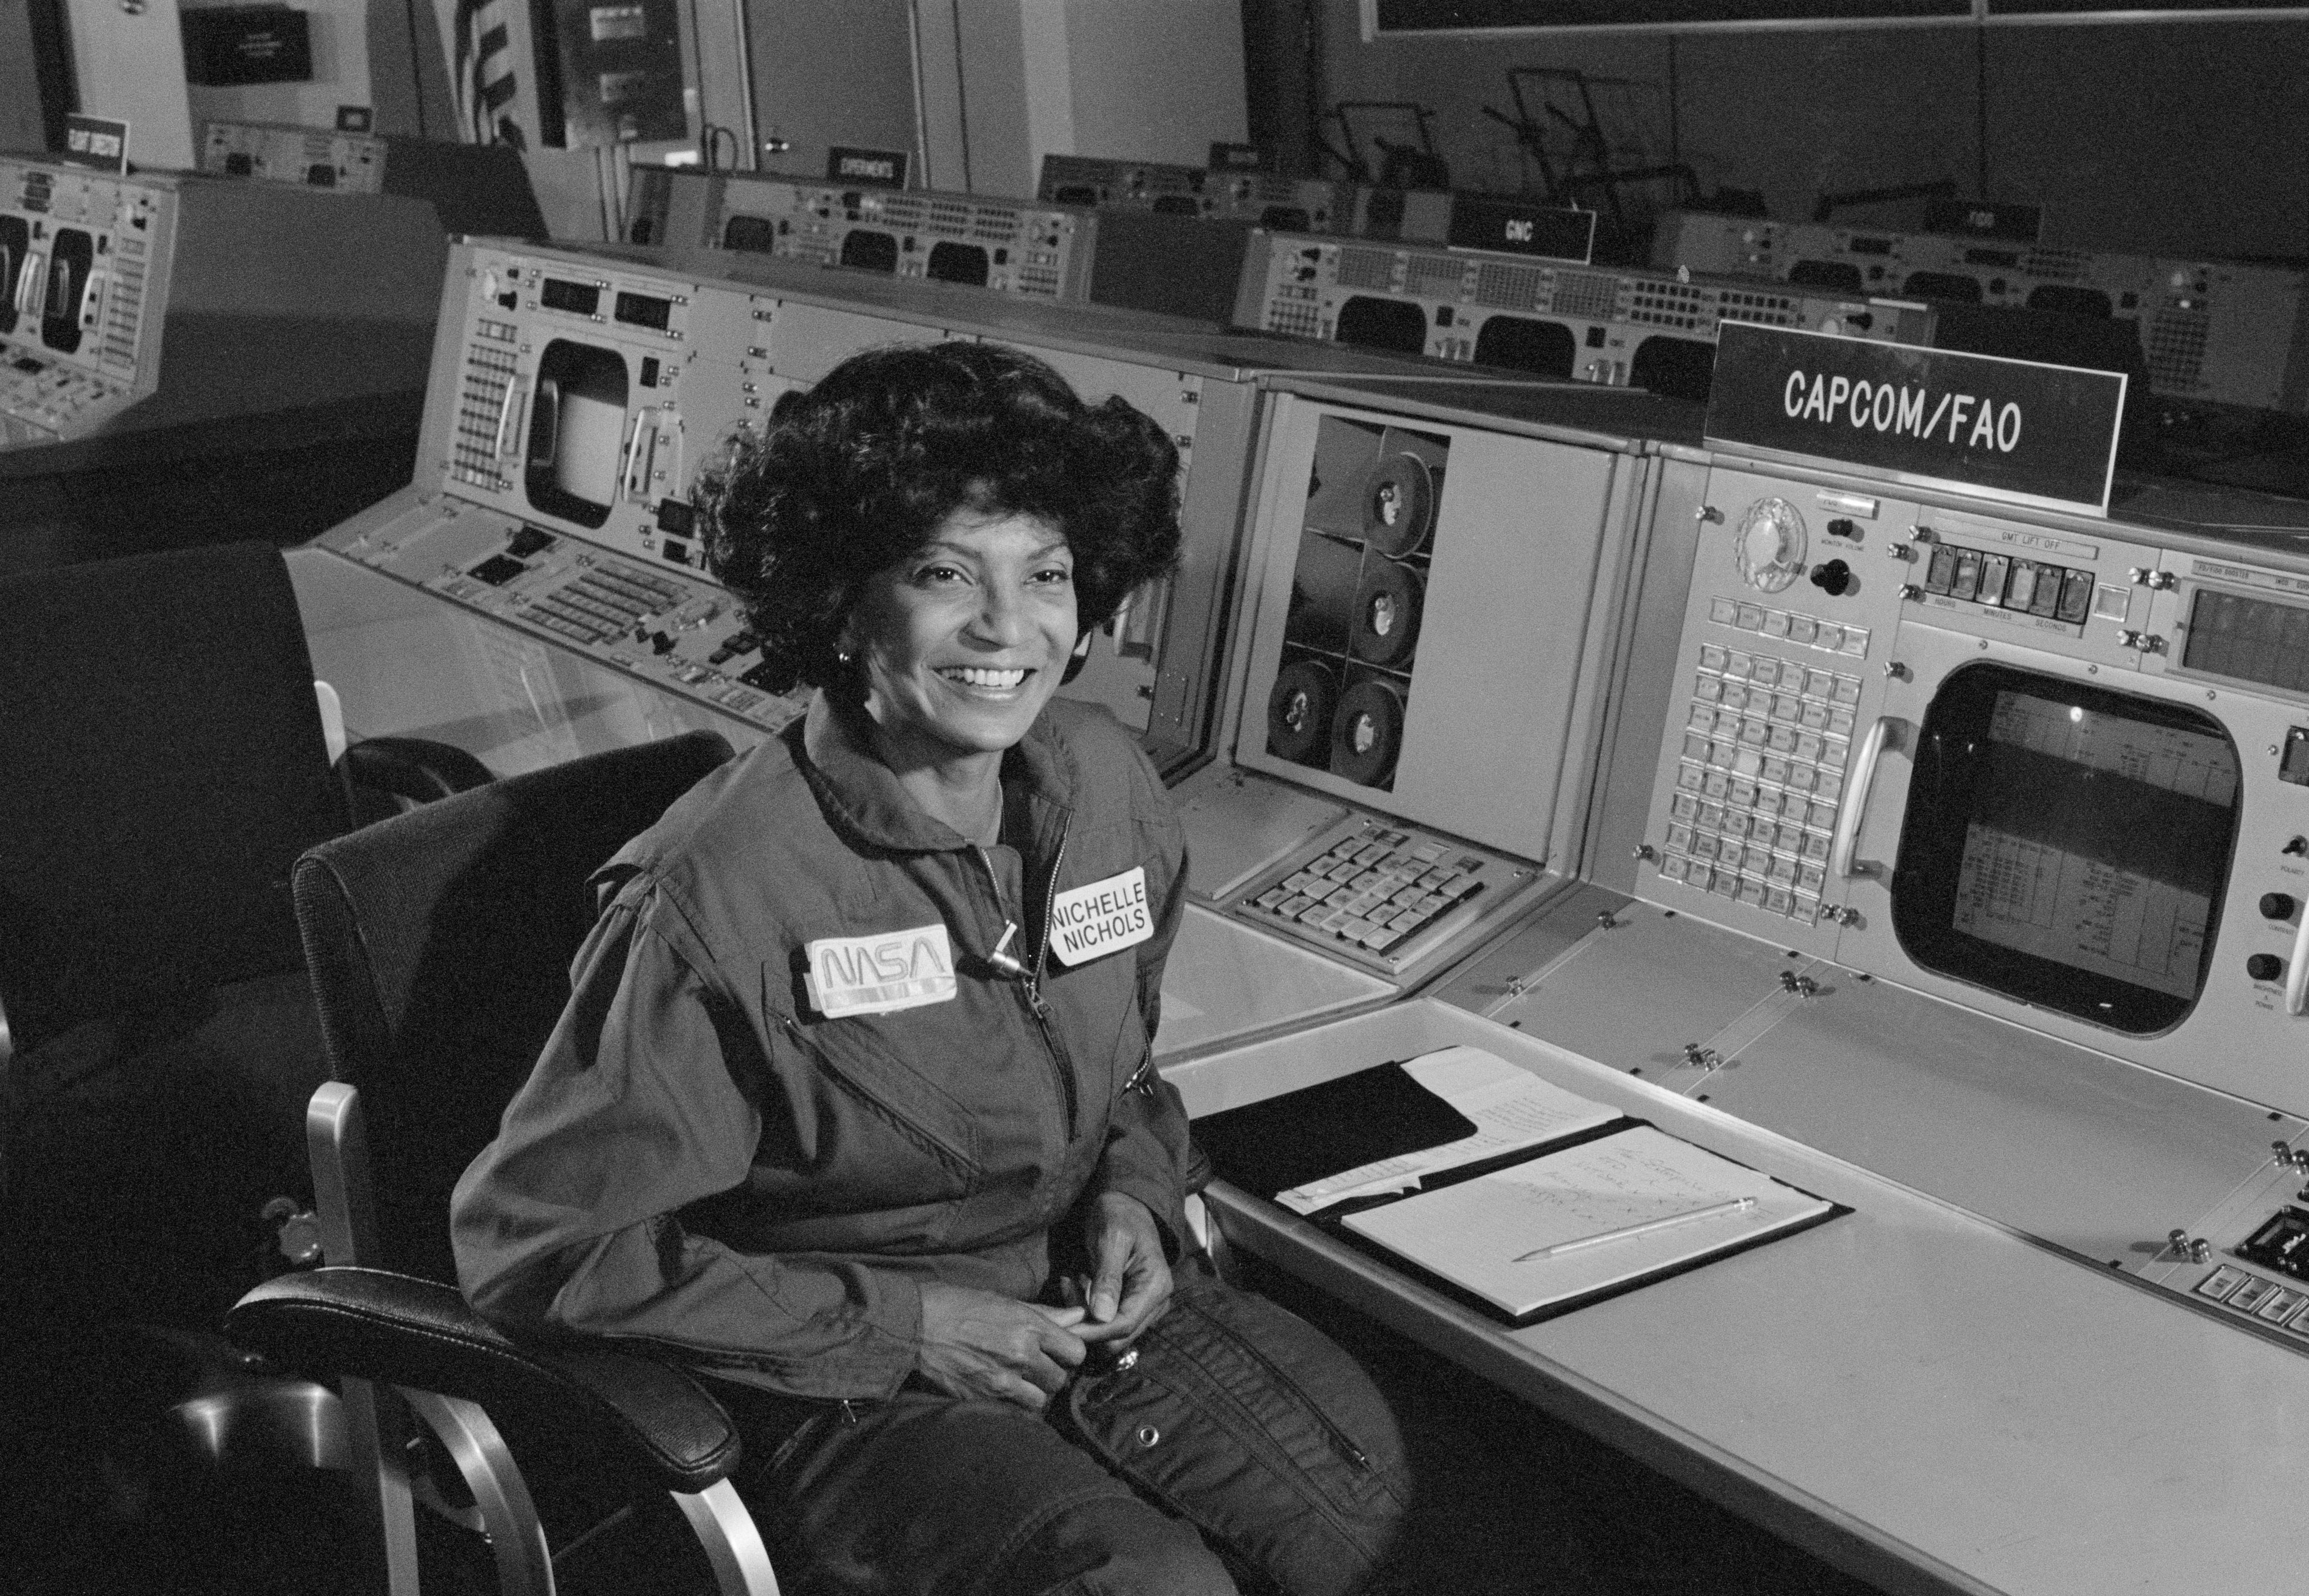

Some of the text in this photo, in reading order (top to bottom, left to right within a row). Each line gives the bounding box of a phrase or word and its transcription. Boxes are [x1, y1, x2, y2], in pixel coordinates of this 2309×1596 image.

[1506, 219, 1533, 241] GNC
[1784, 370, 2022, 453] CAPCOM/FAO
[2002, 531, 2061, 550] GMT LIFT OFF
[1983, 608, 2012, 620] MINUTES
[2035, 618, 2067, 632] SECONDS
[1051, 882, 1145, 931] NICHELLE
[1064, 908, 1145, 953] NICHOLS
[821, 936, 946, 988] NASA
[2255, 1001, 2274, 1011] POWER
